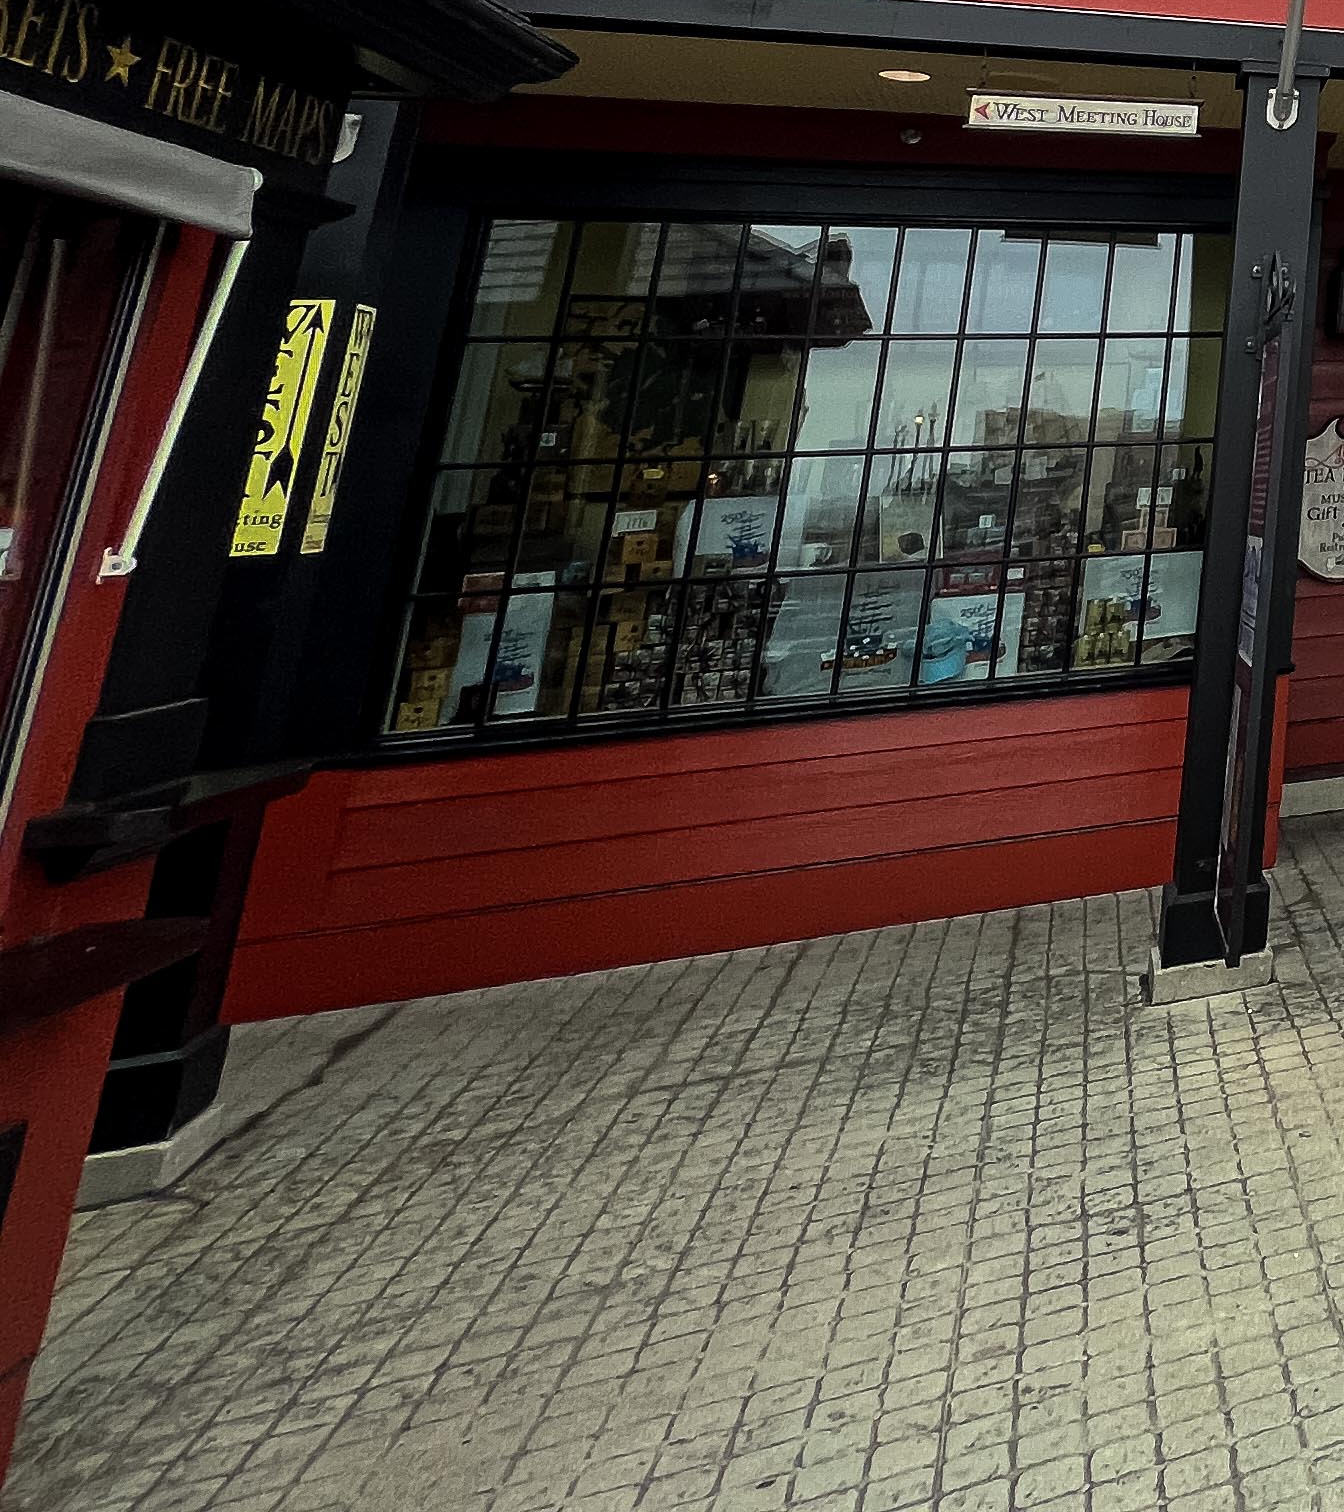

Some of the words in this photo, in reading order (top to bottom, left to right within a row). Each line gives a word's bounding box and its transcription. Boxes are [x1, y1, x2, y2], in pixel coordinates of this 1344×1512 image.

[143, 35, 241, 135] FREE
[239, 75, 337, 166] MAPS
[993, 101, 1048, 123] WEST
[1303, 466, 1336, 485] TEA
[241, 510, 283, 531] ting
[1307, 506, 1338, 521] Gift
